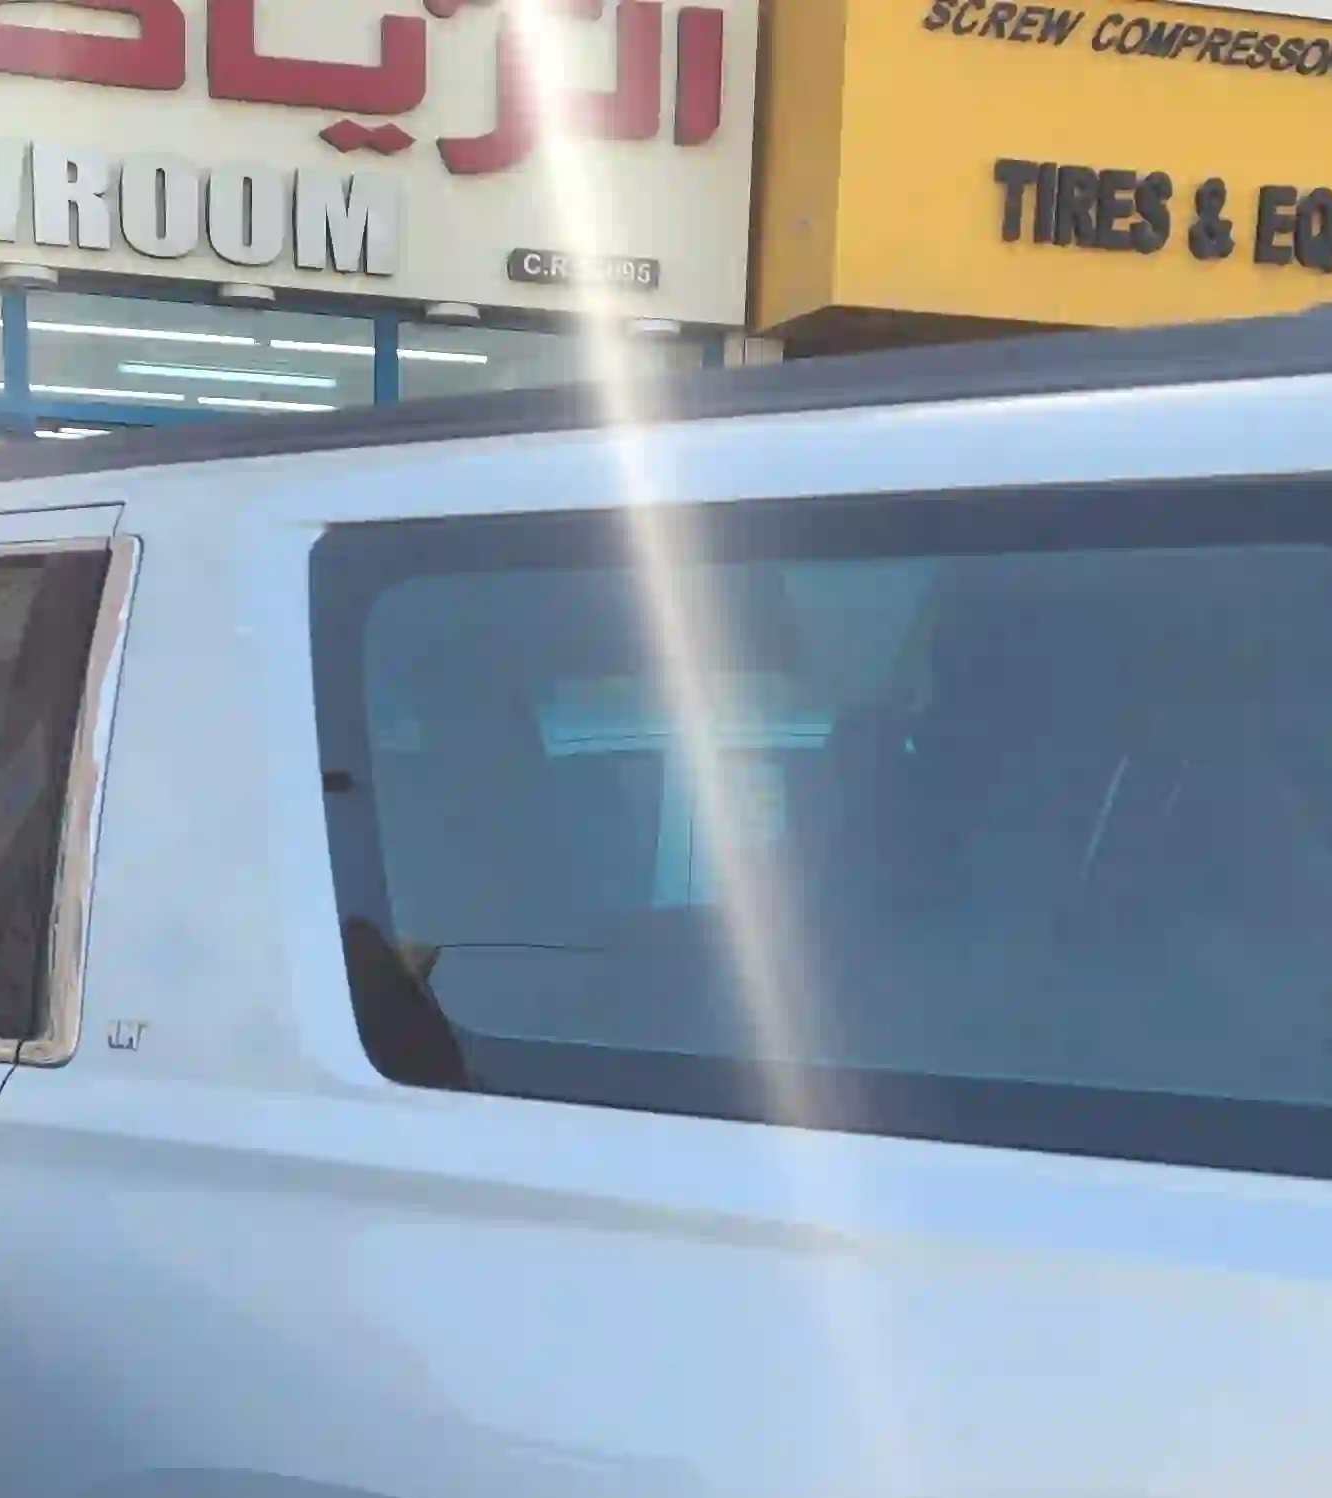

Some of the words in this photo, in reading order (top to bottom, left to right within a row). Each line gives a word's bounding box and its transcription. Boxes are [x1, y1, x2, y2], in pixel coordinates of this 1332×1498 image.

[922, 0, 1086, 46] SCREW
[994, 158, 1173, 254] TIRES
[1188, 177, 1235, 261] &
